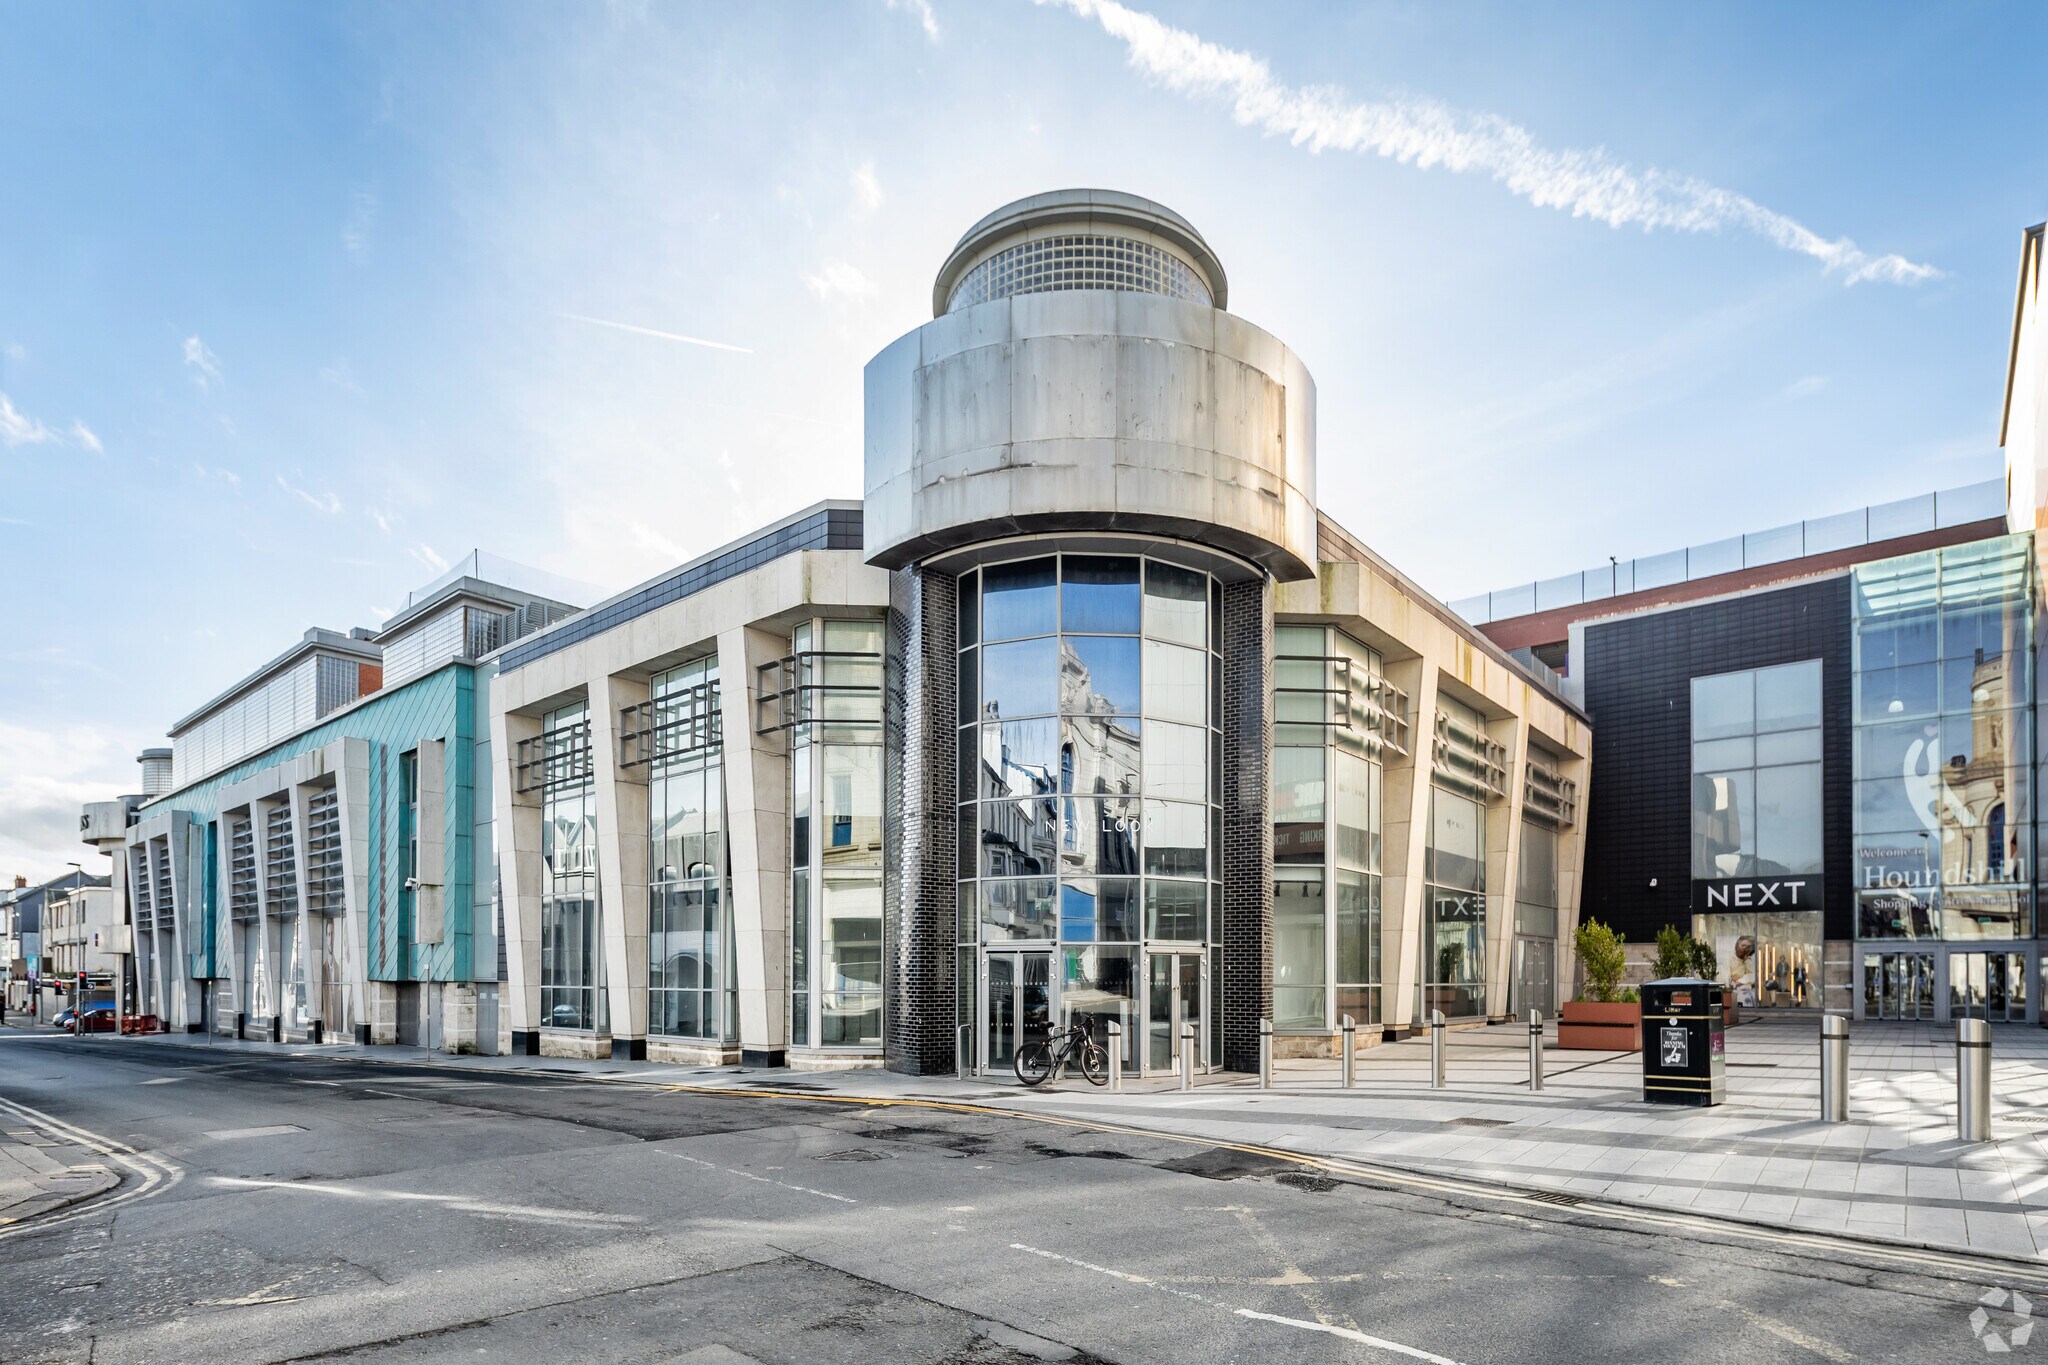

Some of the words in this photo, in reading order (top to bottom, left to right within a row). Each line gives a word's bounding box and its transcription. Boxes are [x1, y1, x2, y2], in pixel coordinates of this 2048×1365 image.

[1045, 820, 1090, 832] NEW
[1102, 820, 1152, 832] LOOK
[1860, 848, 1914, 859] Welcome
[1914, 848, 1926, 857] to
[1864, 858, 2027, 888] Houndshill
[1707, 881, 1806, 908] NEXT
[1873, 897, 1927, 909] Shopping
